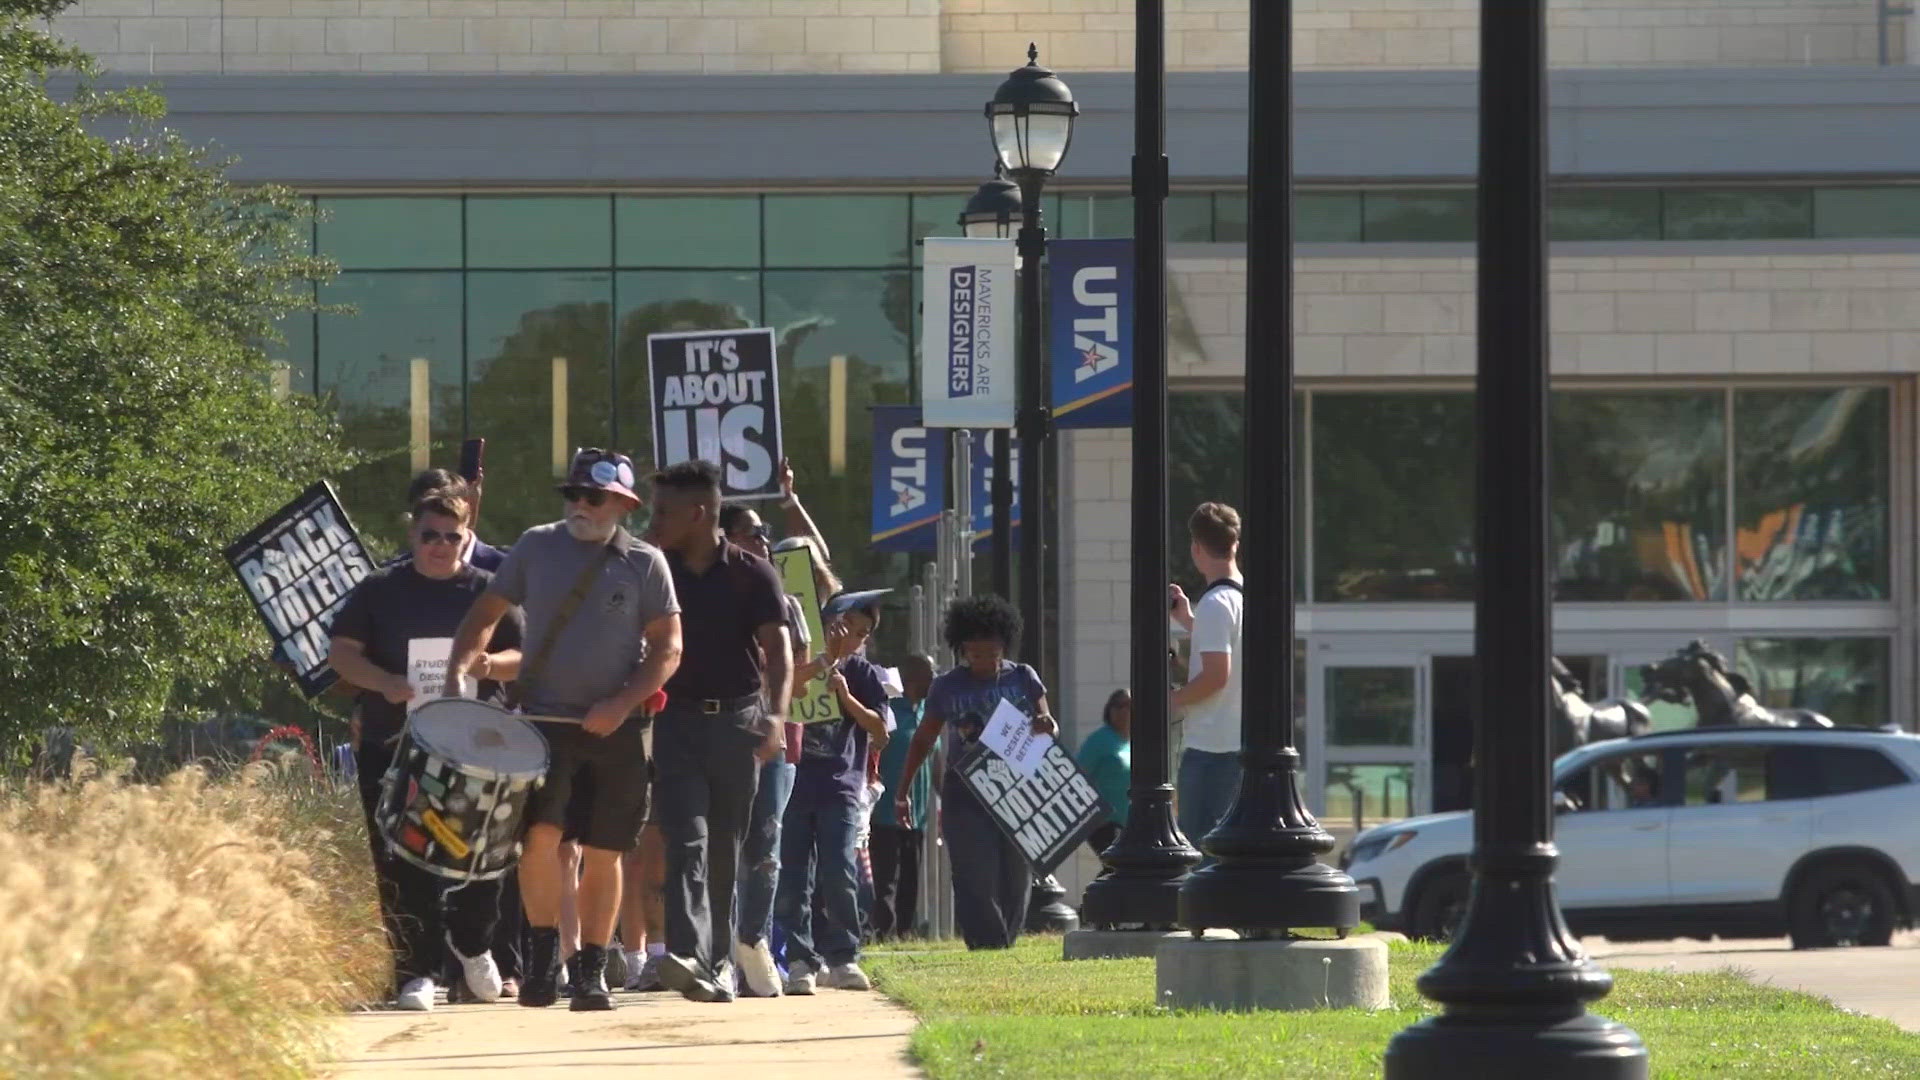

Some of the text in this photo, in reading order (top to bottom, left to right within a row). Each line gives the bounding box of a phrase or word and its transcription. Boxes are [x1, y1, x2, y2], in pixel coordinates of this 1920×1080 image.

[685, 338, 740, 373] IT'S
[952, 272, 971, 392] DESIGNERS
[976, 269, 992, 395] MAVERICKS ARE
[1072, 266, 1119, 384] UTA
[663, 370, 766, 407] ABOUT
[663, 404, 772, 491] US
[890, 427, 927, 517] UTA
[260, 541, 371, 638] VOTERS
[1000, 721, 1013, 737] WE
[992, 745, 1077, 831] VOTERS
[1014, 773, 1100, 861] MATTER
